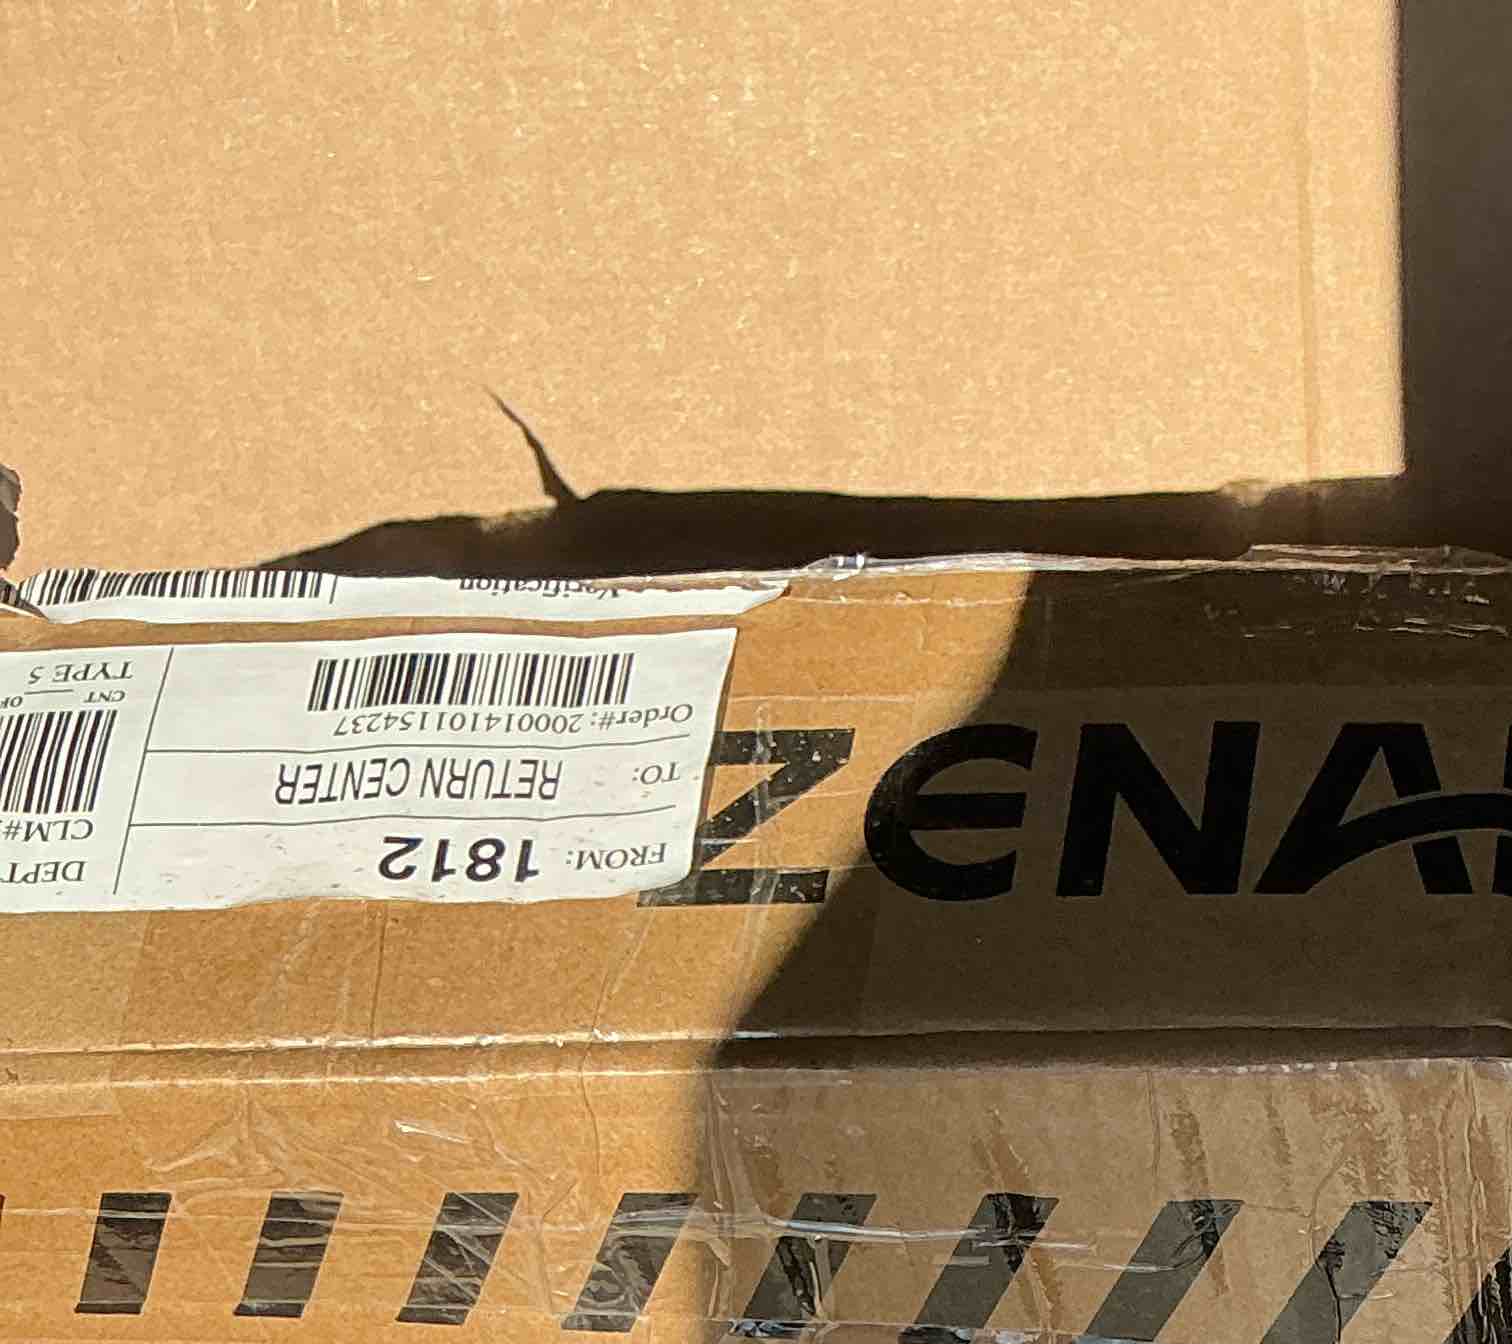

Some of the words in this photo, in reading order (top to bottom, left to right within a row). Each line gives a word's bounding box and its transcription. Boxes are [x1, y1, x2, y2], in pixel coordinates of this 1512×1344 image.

[28, 666, 41, 684] 5
[50, 661, 134, 681] TYPE
[84, 690, 126, 703] CNT
[333, 710, 584, 736] 200014101154237
[590, 703, 693, 725] Order#:
[274, 757, 410, 804] CENTER
[422, 758, 562, 800] RETURN
[633, 762, 682, 784] TO:
[378, 836, 540, 882] 1812
[566, 842, 665, 871] FROM:
